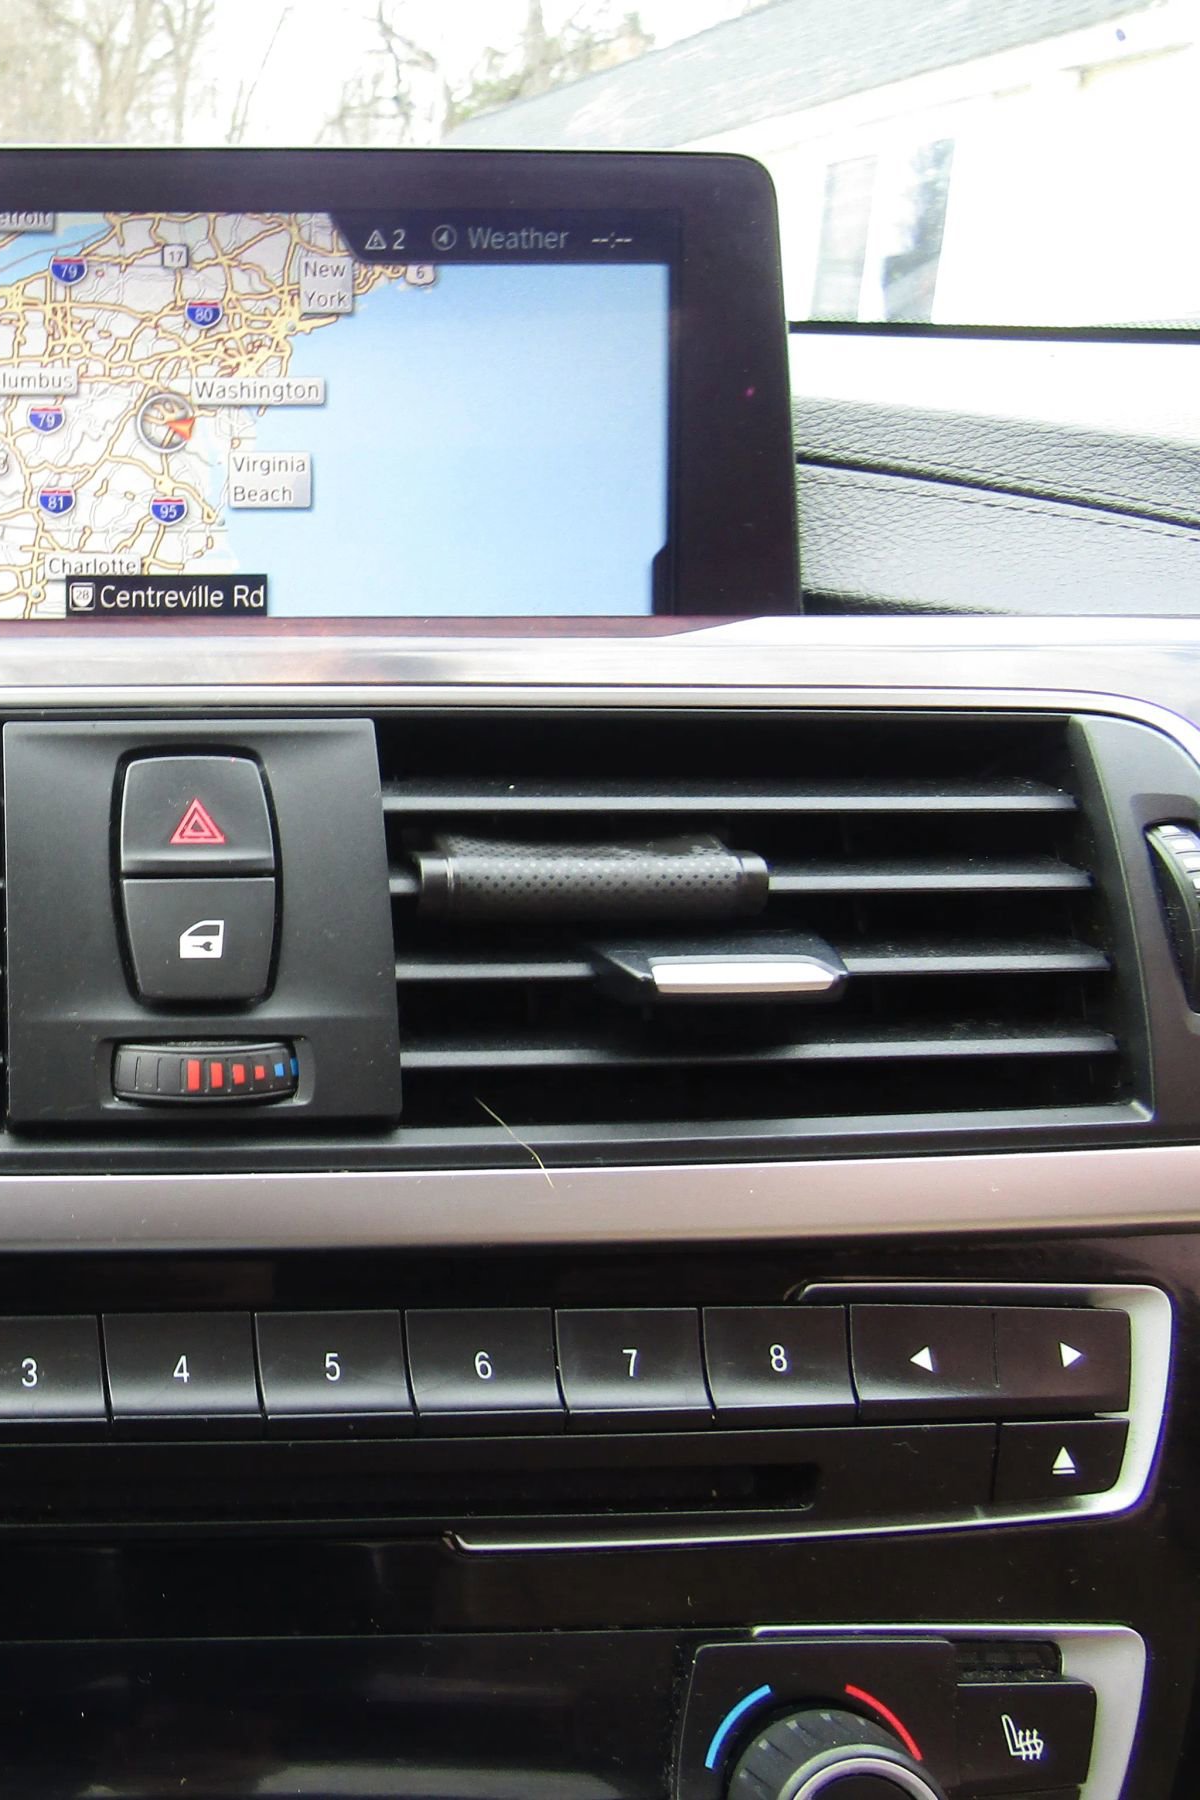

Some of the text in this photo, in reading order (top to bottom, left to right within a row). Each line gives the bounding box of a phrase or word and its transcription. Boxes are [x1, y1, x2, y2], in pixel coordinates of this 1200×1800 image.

[392, 230, 406, 249] 2
[467, 227, 568, 249] Weather
[169, 250, 185, 264] 17
[59, 265, 78, 278] 79
[304, 260, 346, 278] New
[415, 263, 426, 279] 6
[304, 290, 347, 308] York
[195, 308, 213, 322] 80
[195, 380, 320, 402] Washington
[37, 414, 56, 428] 79
[232, 456, 306, 475] Virginia
[47, 496, 65, 510] 81
[233, 486, 292, 502] Beach
[159, 505, 178, 519] 95
[48, 557, 137, 575] Charlotte
[76, 589, 90, 601] 28
[100, 584, 265, 609] Centreville Rd
[324, 1352, 342, 1382] 5
[473, 1351, 493, 1379] 6
[622, 1349, 639, 1377] 7
[769, 1345, 789, 1373] 8
[20, 1357, 39, 1388] 3
[173, 1354, 191, 1383] 4
